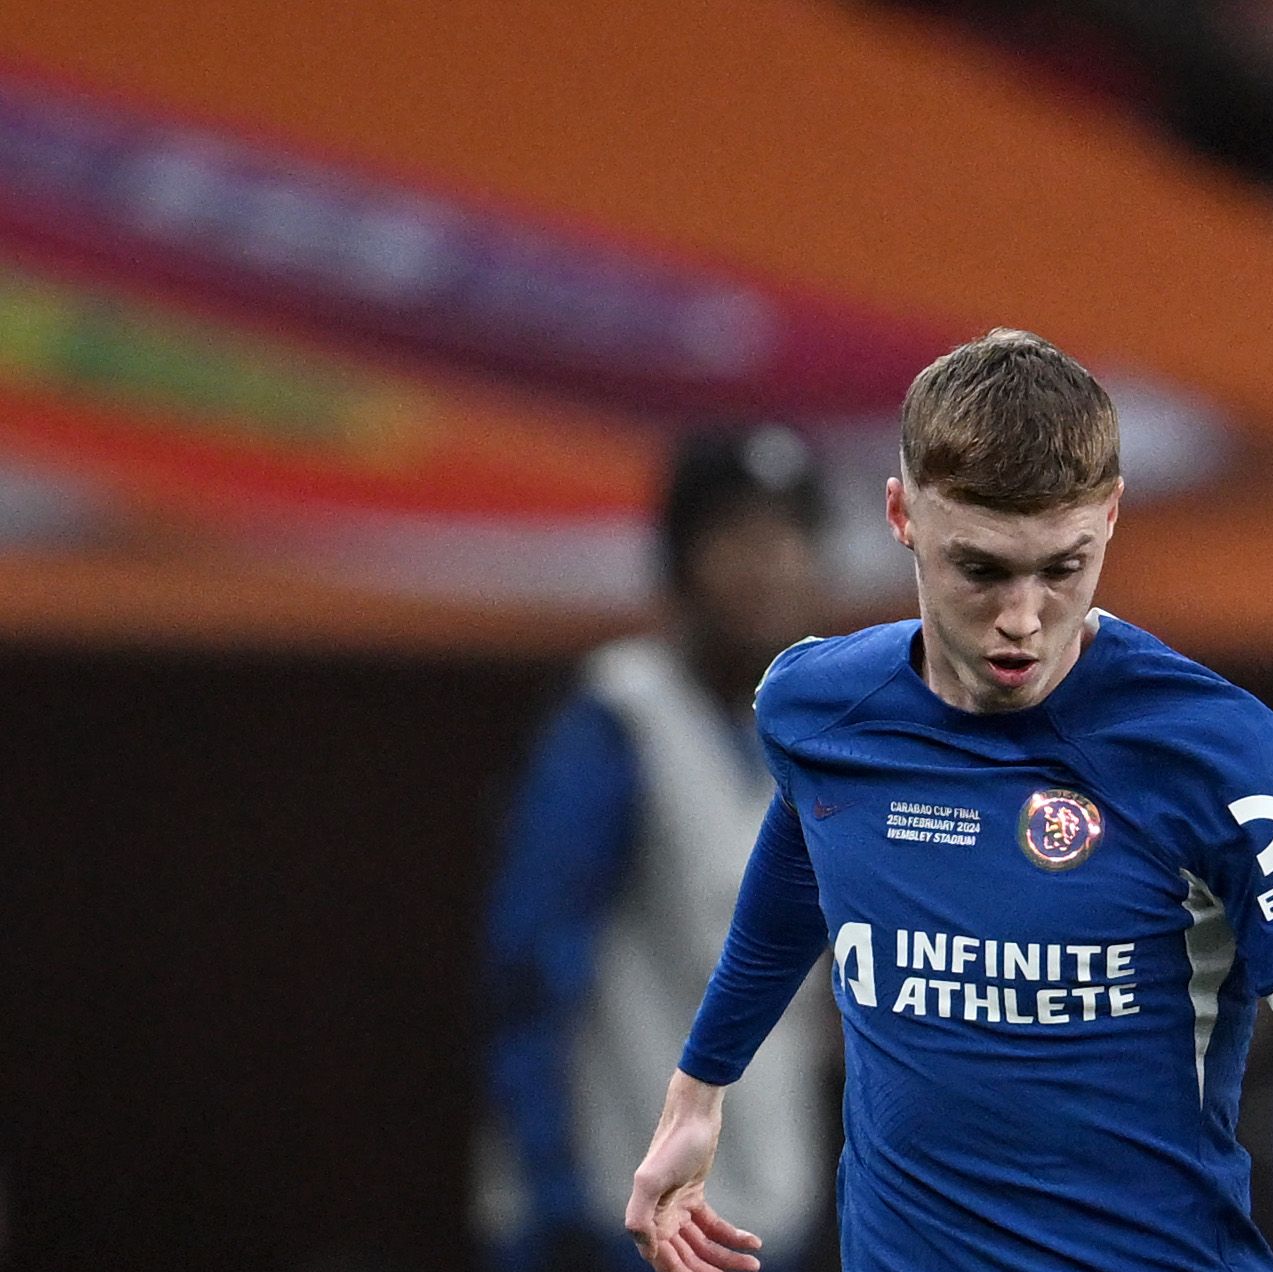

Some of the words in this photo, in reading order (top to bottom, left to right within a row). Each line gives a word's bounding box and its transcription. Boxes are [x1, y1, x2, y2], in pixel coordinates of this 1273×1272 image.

[890, 801, 933, 815] CARABAO
[933, 805, 953, 817] CUP
[953, 808, 981, 820] FINAL
[907, 816, 955, 831] FEBRUARY
[956, 821, 981, 833] 2024
[887, 828, 932, 842] WEMBLEY
[932, 832, 976, 846] STADIUM
[896, 929, 1136, 983] INFINITE
[892, 976, 1141, 1025] ATHLETE
